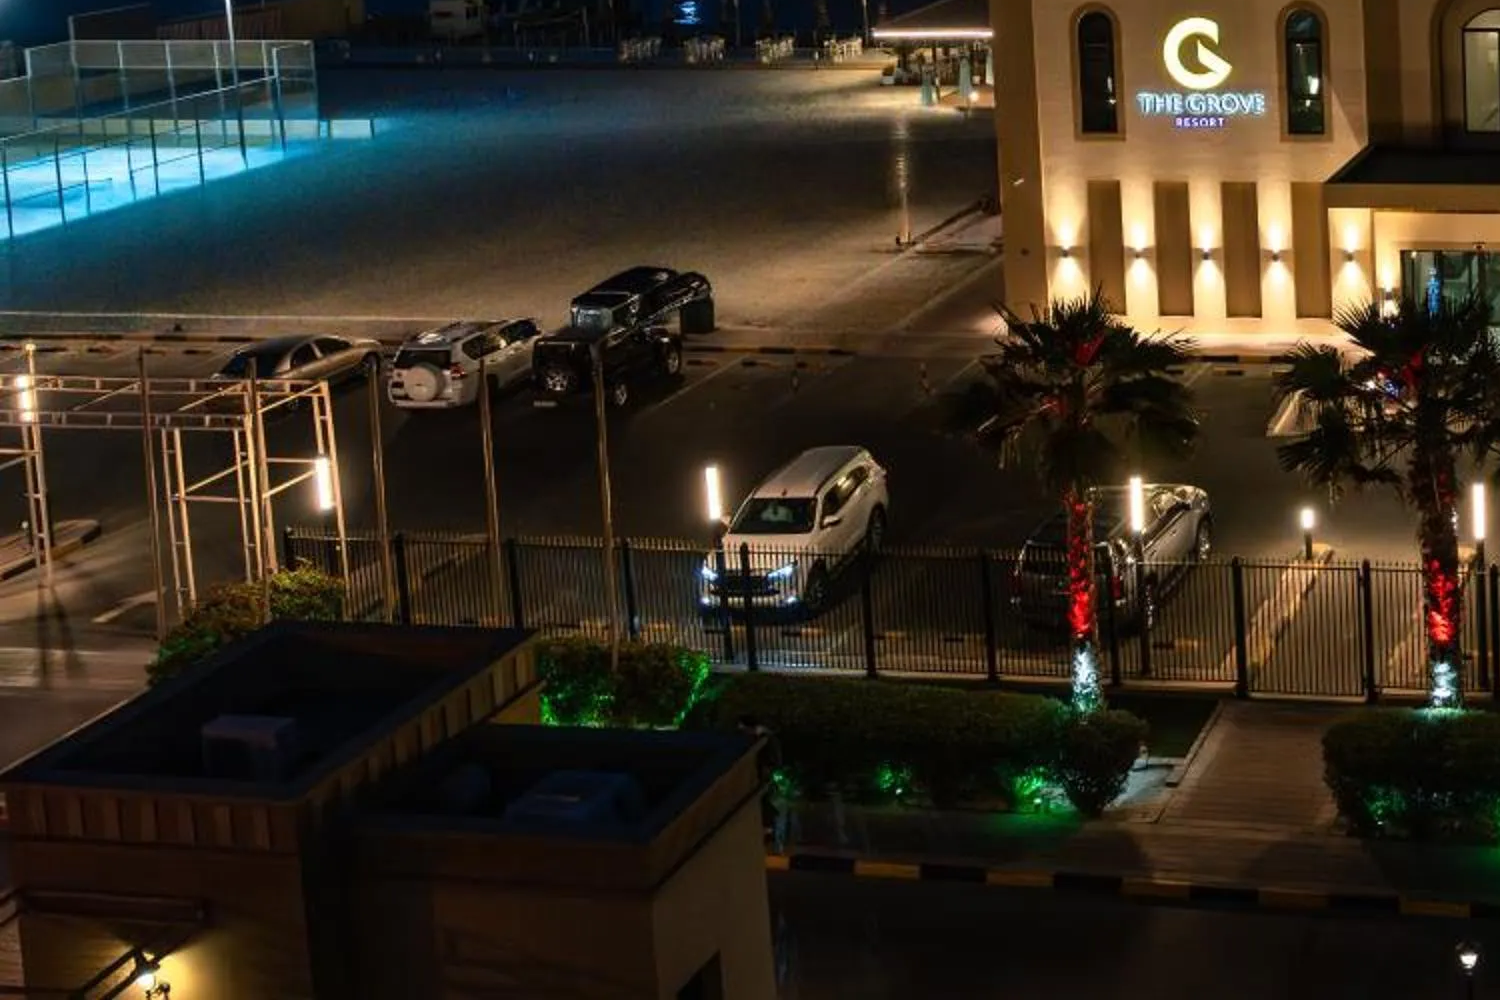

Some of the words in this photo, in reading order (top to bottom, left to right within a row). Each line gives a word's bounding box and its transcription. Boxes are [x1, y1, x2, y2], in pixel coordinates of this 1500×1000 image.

[1137, 92, 1183, 115] THE
[1186, 92, 1266, 115] GROVE
[1175, 117, 1225, 128] RESORT
